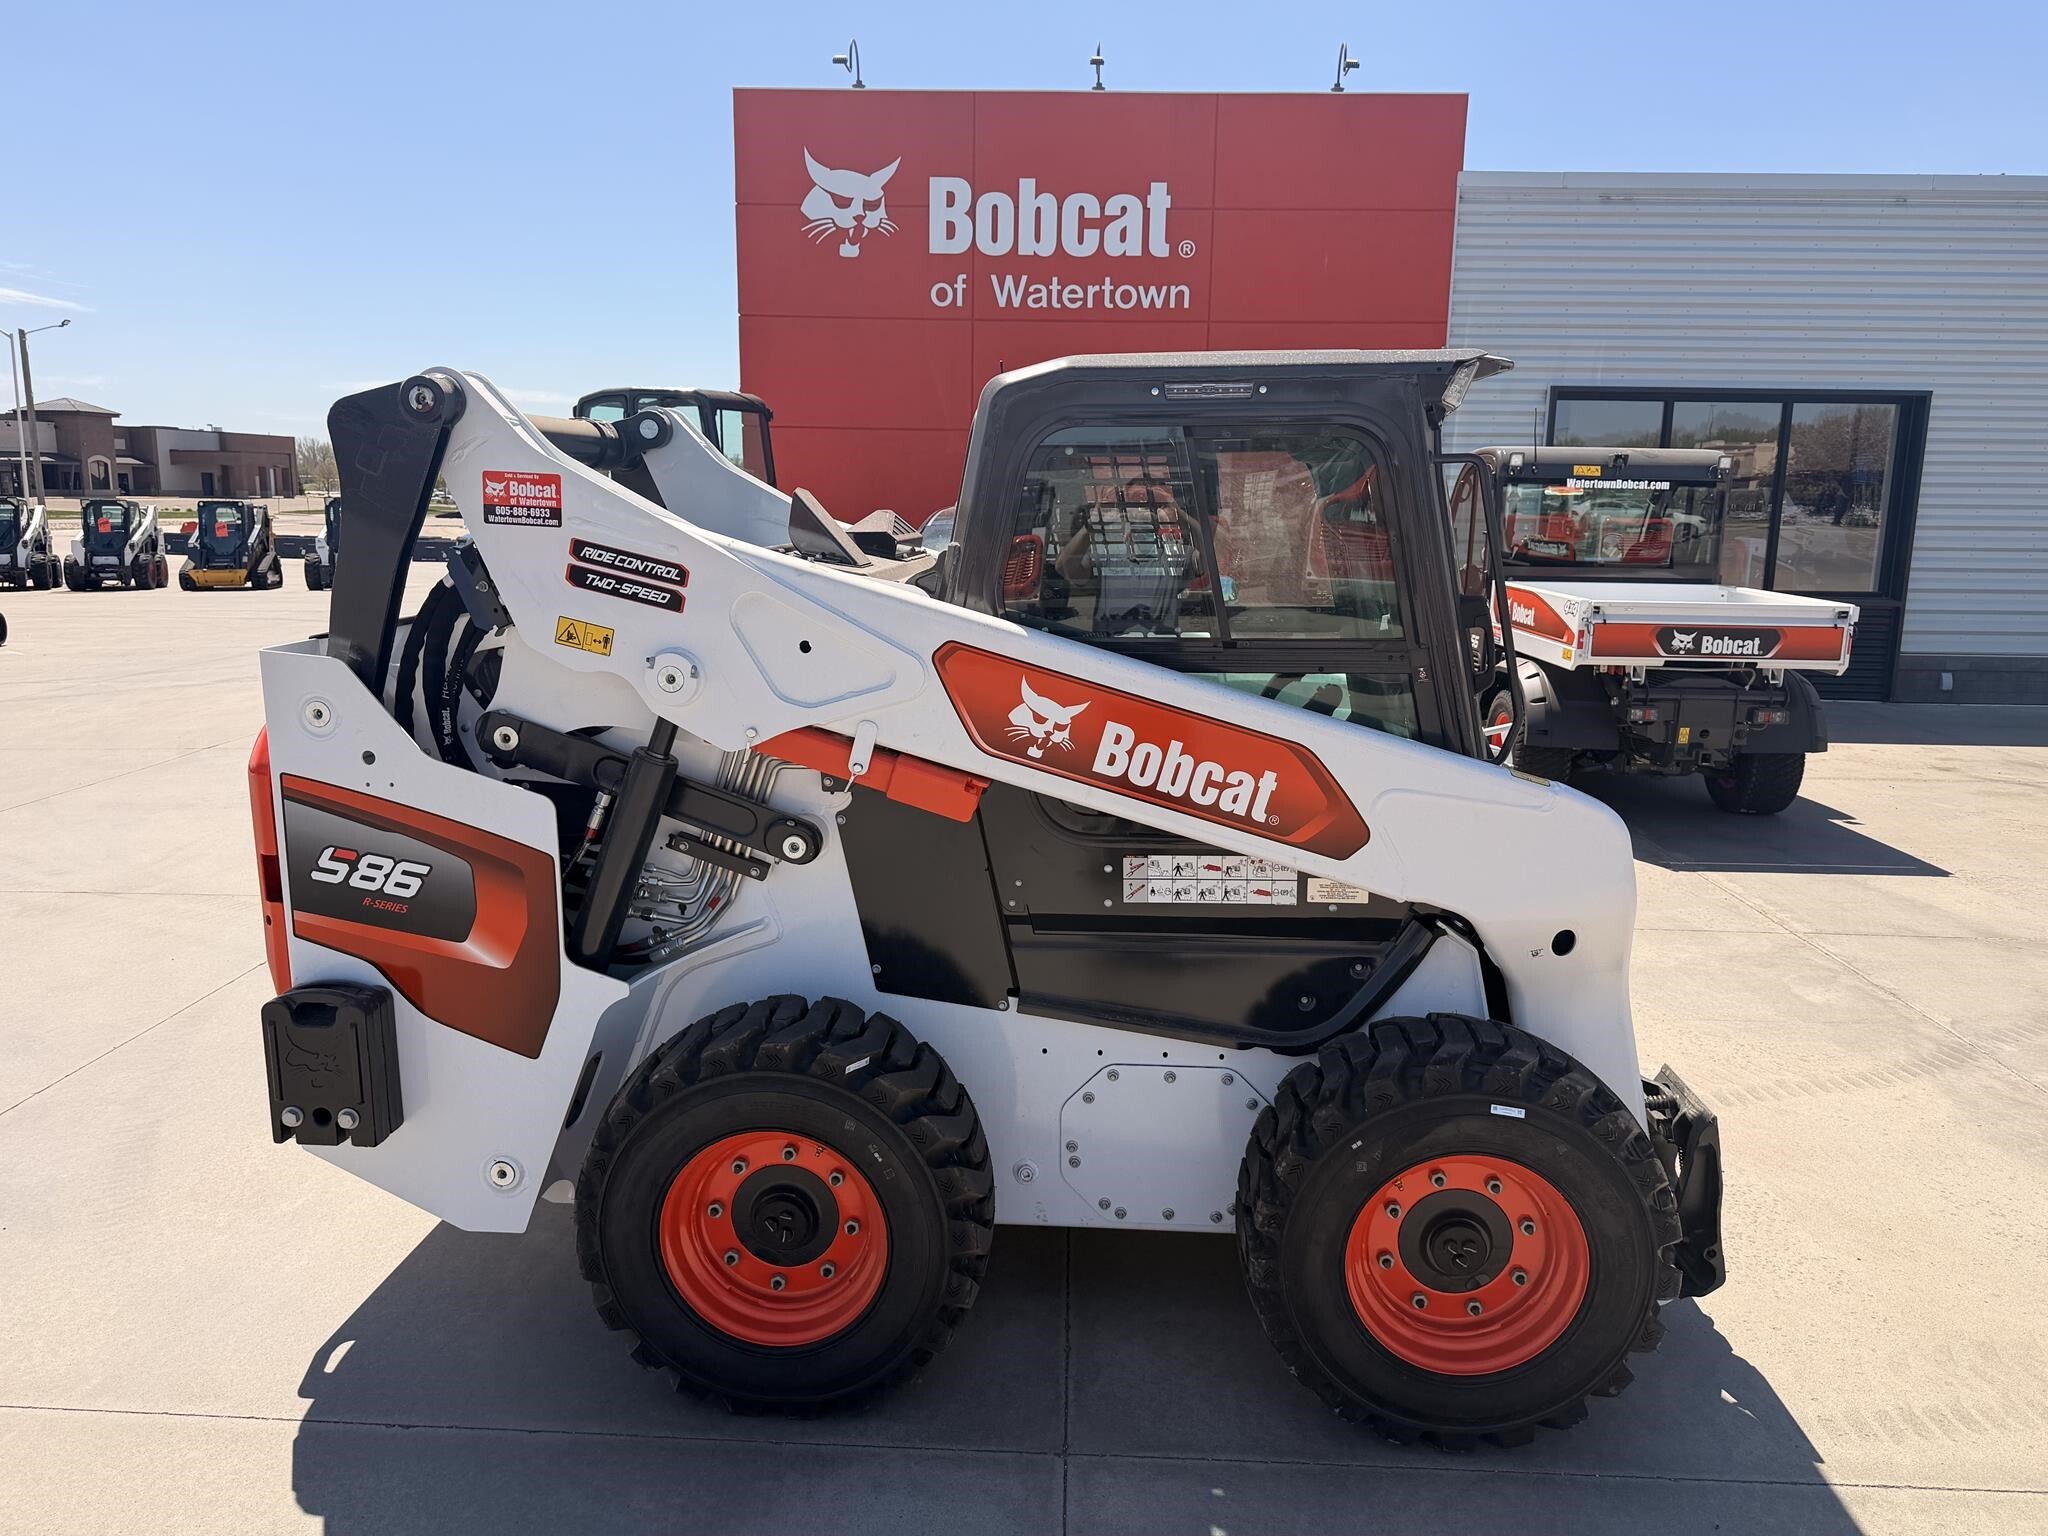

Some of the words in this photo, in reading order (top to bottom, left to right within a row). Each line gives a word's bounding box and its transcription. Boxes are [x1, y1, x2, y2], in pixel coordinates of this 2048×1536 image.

[928, 176, 1172, 258] Bobcat
[930, 273, 967, 308] of
[990, 274, 1190, 309] Watertown
[509, 480, 557, 498] Bobcat
[1566, 478, 1670, 490] WatertownBobcat.com
[495, 505, 550, 518] 605-886-6933
[510, 497, 517, 505] of
[518, 497, 557, 507] Watertown
[487, 514, 559, 526] WatertownBobcat.com
[580, 546, 617, 564] RIDE
[614, 555, 681, 581] CONTROL
[585, 573, 671, 604] TWO-SPEED
[1511, 602, 1536, 627] Bobcat
[1700, 635, 1761, 655] Bobcat
[1092, 720, 1278, 823] Bobcat
[310, 846, 431, 898] S86
[362, 897, 409, 914] R-SERIES
